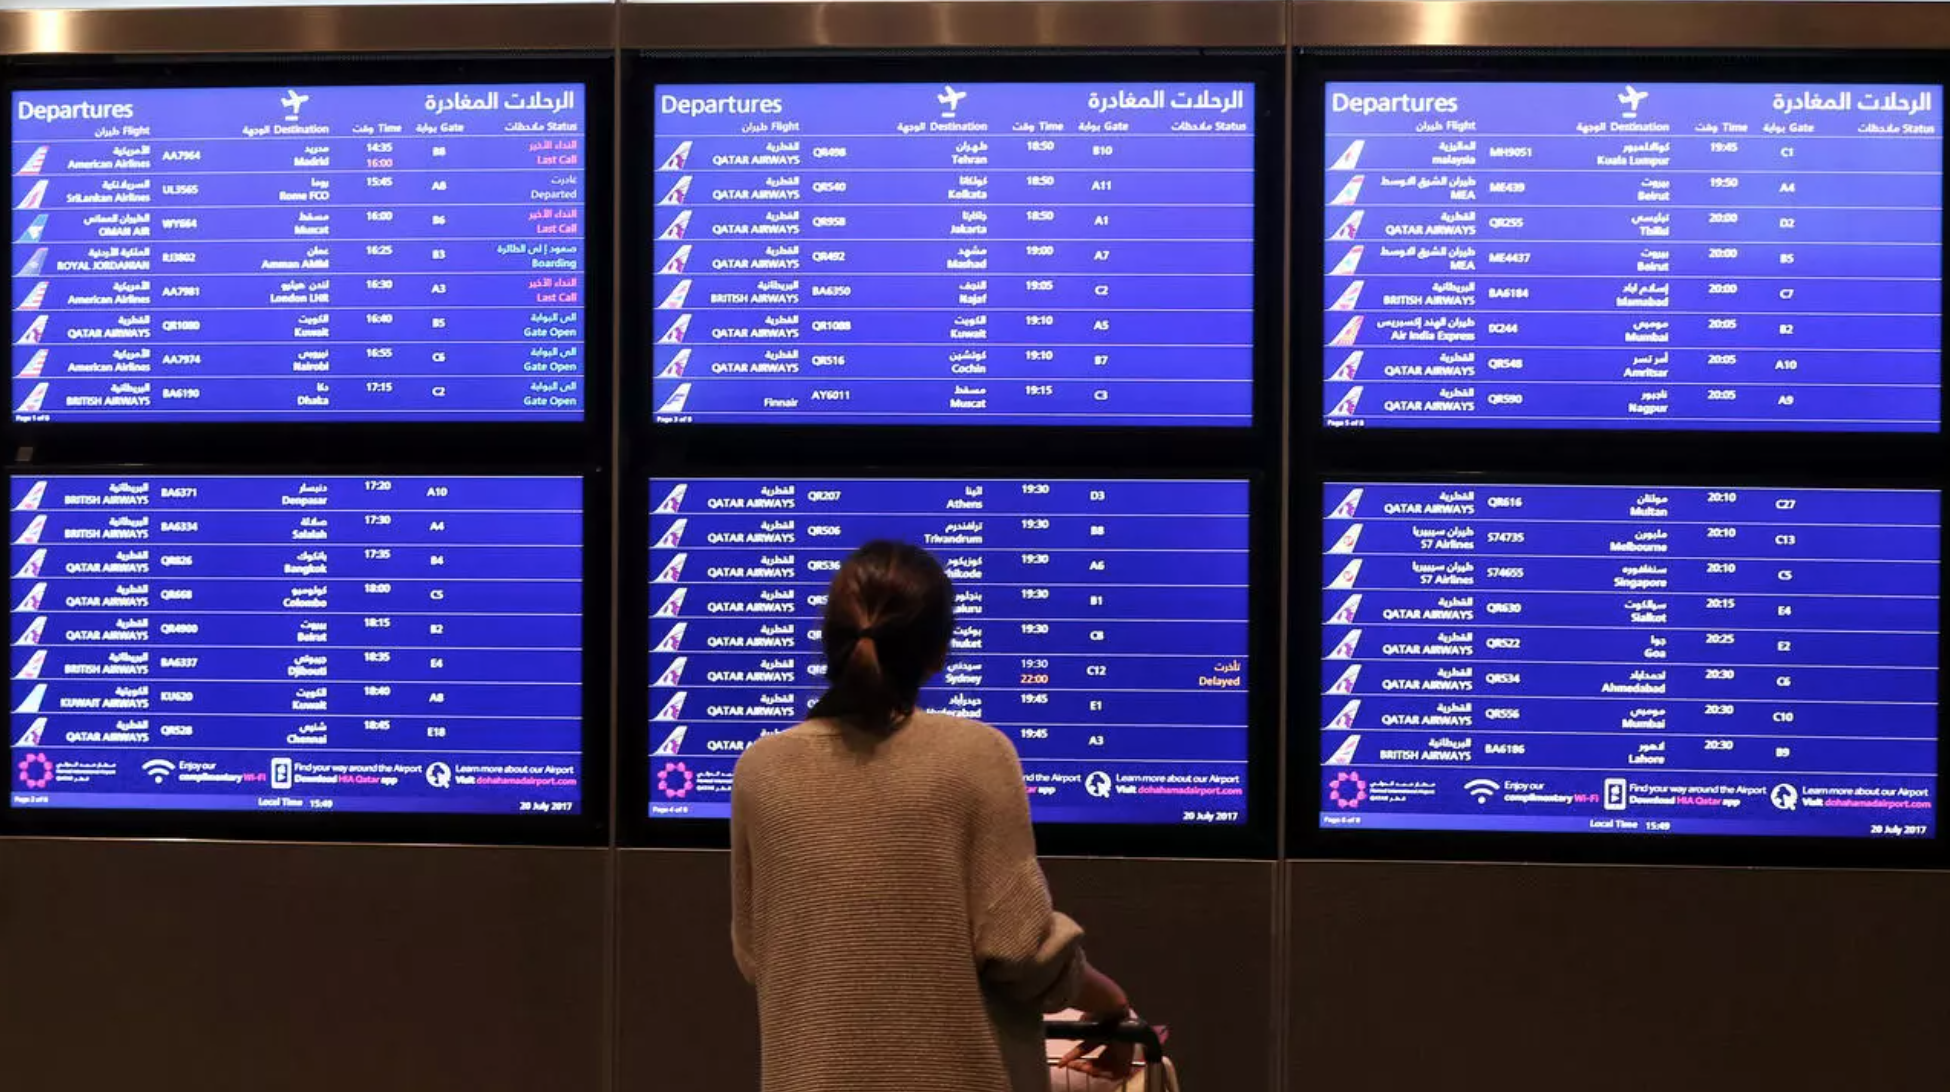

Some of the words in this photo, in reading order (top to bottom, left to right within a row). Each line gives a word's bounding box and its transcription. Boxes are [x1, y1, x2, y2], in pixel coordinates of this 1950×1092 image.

[424, 91, 499, 115] المغادرة
[503, 90, 575, 114] الرحلات
[661, 94, 783, 118] Departures
[1087, 89, 1165, 113] المغادرة
[1169, 89, 1244, 113] الرحلات
[1332, 92, 1459, 116] Departures
[1772, 91, 1852, 115] المغادرة
[1856, 91, 1932, 116] الرحلات
[18, 100, 134, 123] Departures
[122, 125, 151, 138] Flight
[273, 123, 330, 135] Destination
[377, 123, 403, 133] Time
[439, 122, 465, 133] Gate
[546, 121, 578, 132] Status
[770, 120, 800, 133] Flight
[896, 121, 927, 135] الوجهة
[929, 121, 989, 132] Destination
[1038, 120, 1065, 132] Time
[1103, 120, 1130, 132] Gate
[1214, 121, 1247, 131] Status
[1445, 120, 1477, 133] Flight
[1609, 121, 1671, 132] Destination
[1721, 121, 1749, 133] Time
[1788, 122, 1815, 133] Gate
[1901, 123, 1936, 134] Status
[366, 142, 394, 153] 14:35
[1780, 146, 1794, 158] C1
[67, 159, 112, 170] American
[111, 158, 151, 169] Airlines
[366, 157, 394, 168] 16:00
[536, 155, 557, 165] Last
[557, 154, 578, 165] Call
[712, 154, 750, 167] QATAR
[750, 154, 801, 165] AIRWAYS
[951, 151, 988, 165] Tehran
[1596, 154, 1628, 166] Kuala
[1628, 155, 1671, 168] Lumpur
[1091, 180, 1112, 191] A11
[308, 190, 331, 201] FCO
[530, 188, 578, 201] Departed
[1450, 189, 1476, 200] MEA
[1637, 190, 1670, 202] Beirut
[1093, 215, 1109, 226] A1
[536, 224, 557, 234] Last
[558, 223, 578, 234] Call
[1384, 224, 1424, 237] QATAR
[1424, 224, 1477, 236] AIRWAYS
[1025, 245, 1055, 256] 19:00
[1093, 250, 1110, 261] A7
[531, 257, 578, 270] Boarding
[365, 279, 394, 289] 16:30
[430, 283, 447, 294] A3
[1025, 279, 1054, 291] 19:05
[1094, 285, 1109, 296] C2
[269, 292, 308, 304] London
[536, 293, 557, 303] Last
[558, 291, 578, 303] Call
[1025, 314, 1054, 326] 19:10
[1093, 319, 1110, 331] A5
[1707, 318, 1738, 330] 20:05
[523, 327, 548, 337] Gate
[548, 327, 577, 339] Open
[366, 347, 393, 358] 16:55
[1025, 349, 1054, 361] 19:10
[523, 361, 548, 372] Gate
[549, 361, 578, 373] Open
[950, 363, 987, 374] Cochin
[1774, 359, 1798, 370] A10
[1623, 366, 1669, 378] Amritsar
[366, 382, 393, 392] 17:15
[431, 386, 446, 397] C2
[1025, 385, 1053, 396] 19:15
[296, 395, 330, 406] Dhaka
[810, 390, 850, 401] AY6011
[1093, 389, 1109, 401] C3
[1707, 389, 1737, 400] 20:05
[1777, 395, 1795, 405] A9
[523, 395, 548, 406] Gate
[549, 396, 577, 408] Open
[763, 397, 799, 408] Finnair
[949, 398, 987, 409] Muscat
[1628, 402, 1669, 416] Nagpur
[364, 480, 392, 491] 17:20
[426, 486, 449, 497] A10
[1021, 483, 1050, 494] 19:30
[281, 495, 328, 507] Denpasar
[1089, 490, 1106, 501] D3
[1707, 491, 1737, 503] 20:10
[945, 498, 984, 509] Athens
[1775, 498, 1797, 510] C27
[364, 514, 392, 525] 17:30
[429, 521, 445, 531] A4
[923, 533, 983, 544] Trivandrum
[1420, 538, 1434, 549] S7
[1434, 538, 1475, 550] Airlines
[1774, 534, 1796, 545] C13
[1090, 595, 1103, 606] B1
[1705, 597, 1736, 609] 20:15
[1777, 640, 1792, 652] E2
[1643, 647, 1667, 659] Goa
[64, 663, 101, 675] BRITISH
[101, 664, 149, 675] AIRWAYS
[1021, 658, 1049, 669] 19:30
[1086, 665, 1107, 676] C12
[944, 672, 983, 686] Sydney
[1020, 674, 1049, 684] 22:00
[1198, 675, 1241, 688] Delayed
[1601, 682, 1666, 694] Ahmedabad
[1020, 693, 1049, 704] 19:45
[1089, 700, 1103, 711] E1
[1772, 711, 1794, 722] C10
[1628, 753, 1666, 765] Lahore
[178, 760, 201, 772] Enjoy
[199, 762, 217, 771] our
[293, 762, 313, 772] Find
[345, 763, 378, 773] around
[376, 763, 393, 773] the
[391, 763, 423, 775] Airport
[338, 774, 356, 784] HIA
[354, 774, 382, 784] Qatar
[380, 776, 399, 786] app
[1115, 773, 1140, 783] Learn
[1164, 774, 1193, 783] about
[1208, 774, 1240, 785] Airport
[1115, 784, 1138, 794] Visit
[1137, 785, 1244, 797] dohahamadairport.com
[1503, 780, 1530, 792] Enjoy
[1528, 783, 1545, 791] our
[1802, 785, 1828, 795] Learn
[1852, 786, 1880, 797] about
[1896, 787, 1929, 797] Airport
[1572, 793, 1600, 803] Wi-Fi
[1196, 810, 1215, 823] July
[1215, 811, 1239, 821] 2017
